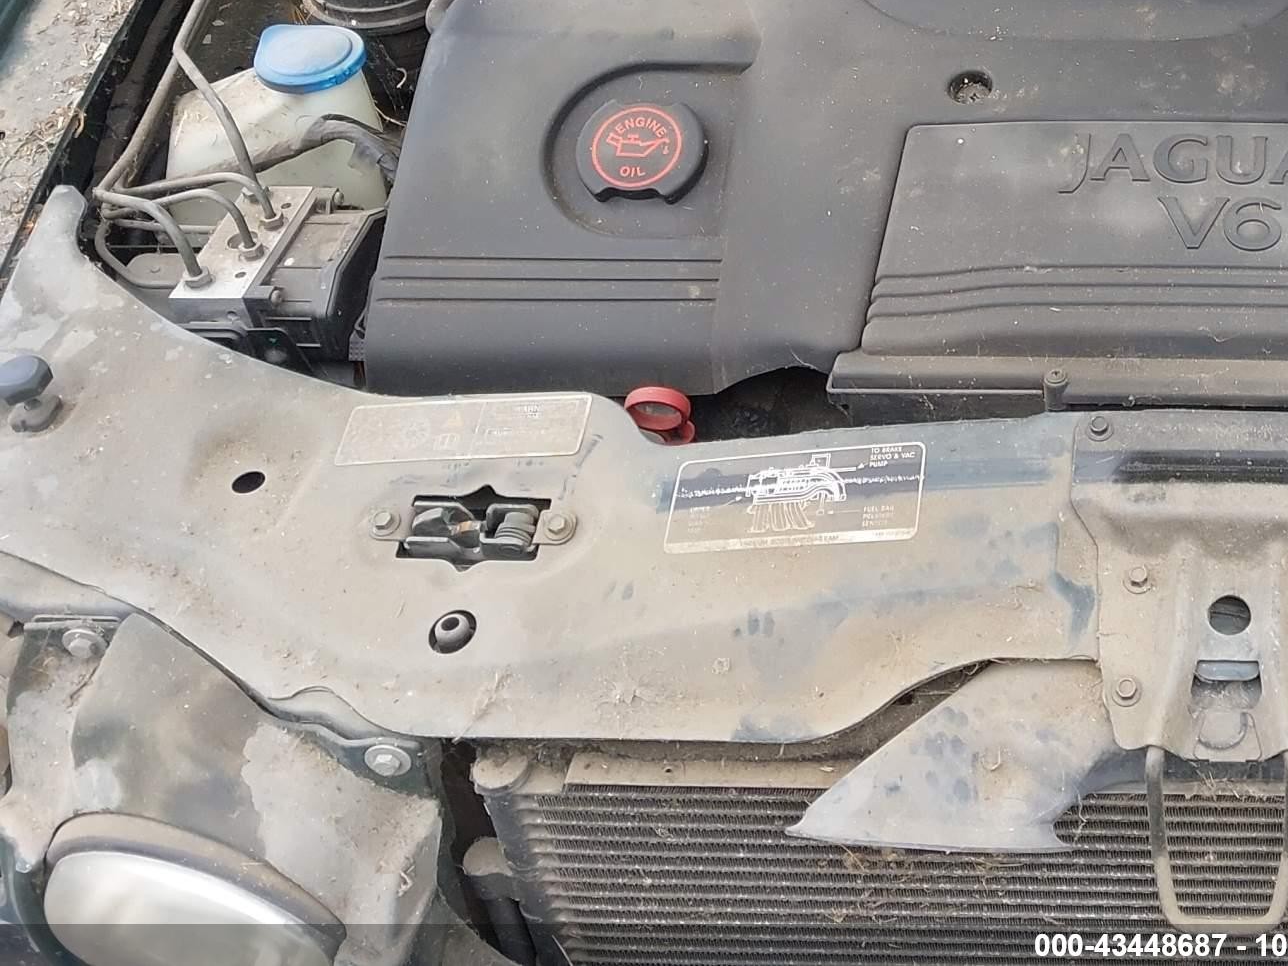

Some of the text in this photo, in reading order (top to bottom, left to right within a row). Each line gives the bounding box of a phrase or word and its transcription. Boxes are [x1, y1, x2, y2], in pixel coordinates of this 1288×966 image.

[615, 117, 667, 138] ENGINE
[619, 166, 646, 178] OIL
[1157, 196, 1282, 252] V6
[870, 453, 892, 461] SERVO
[869, 460, 889, 468] PUMP
